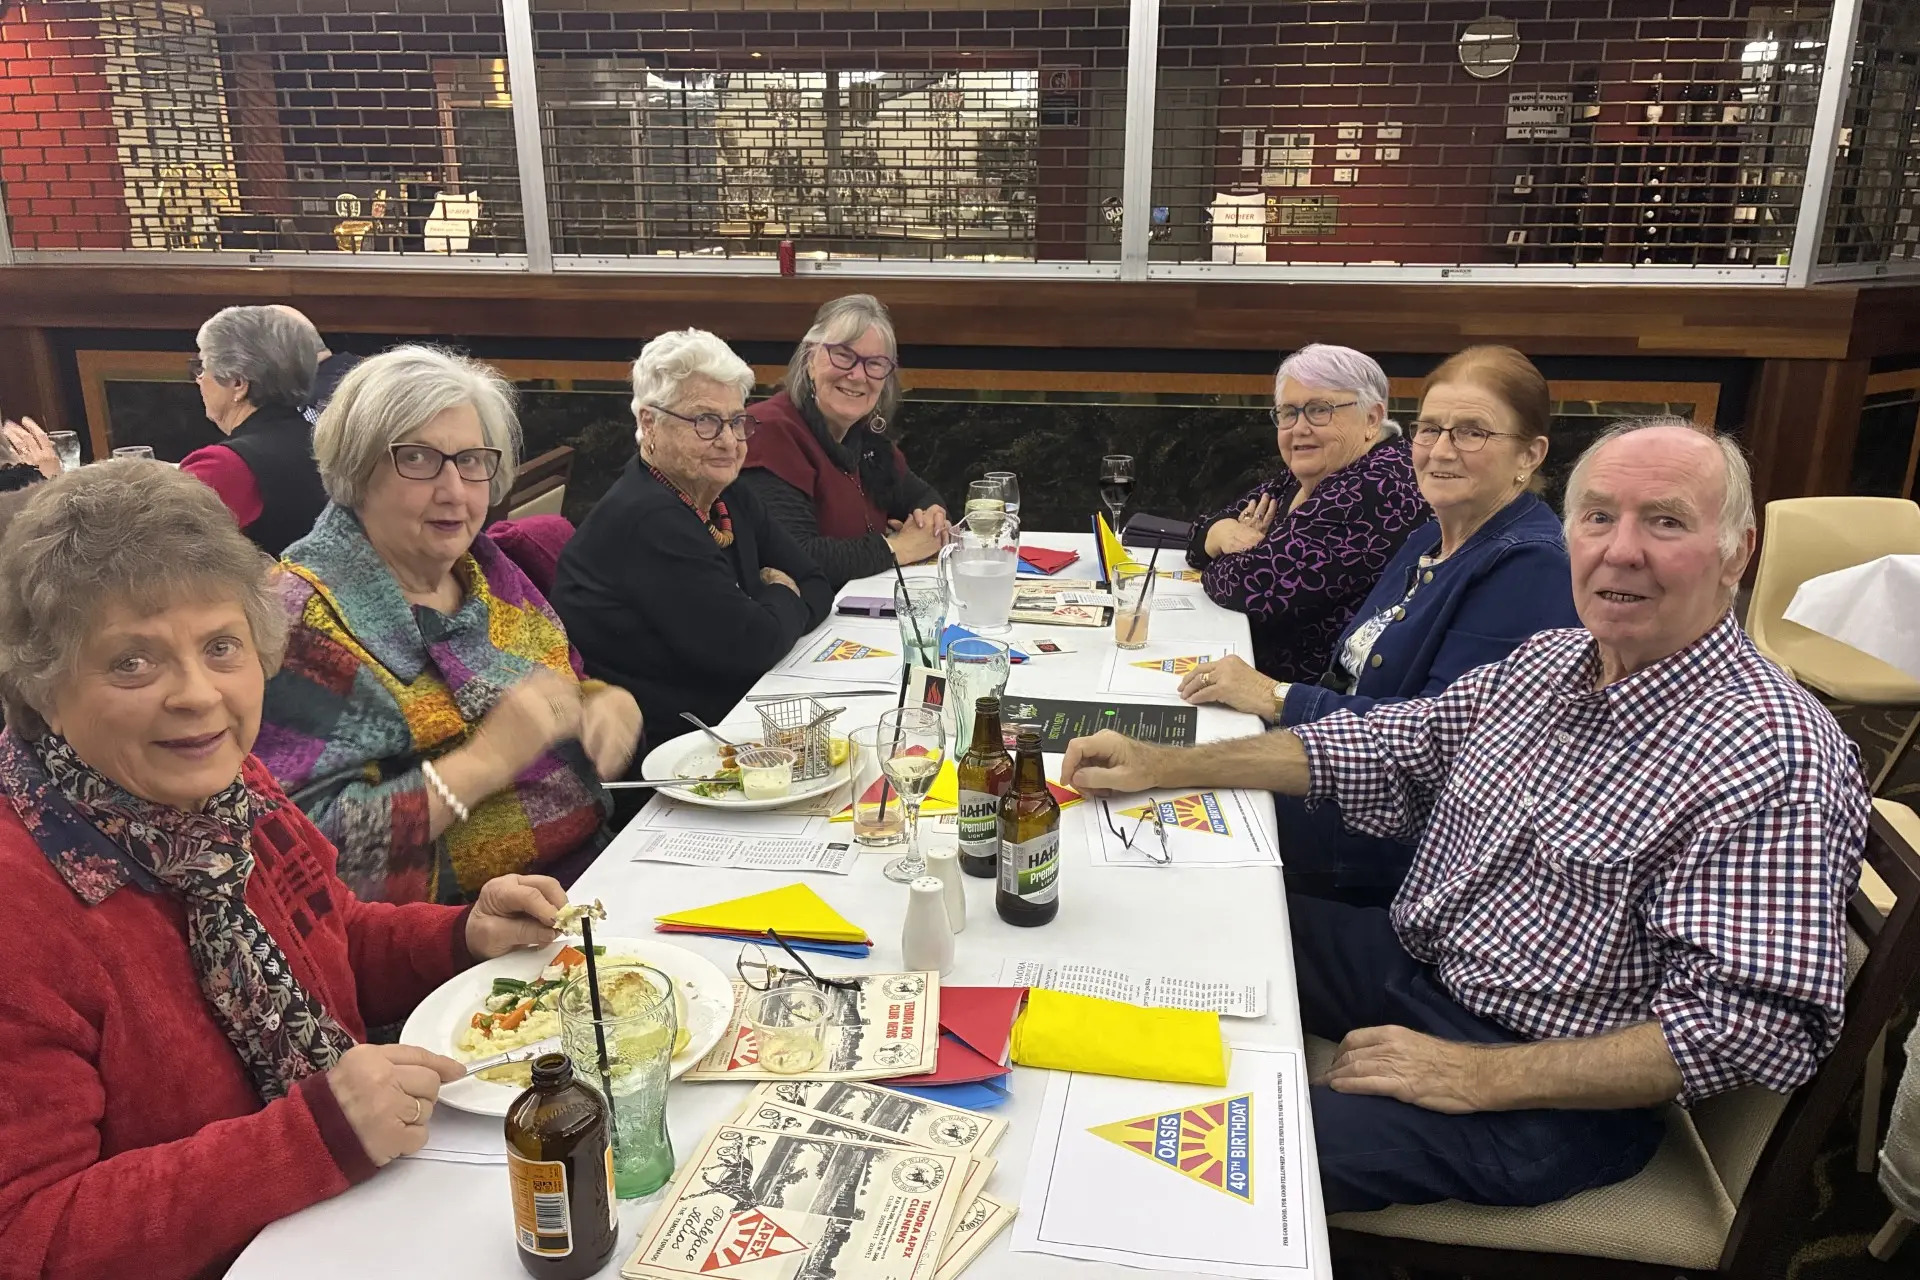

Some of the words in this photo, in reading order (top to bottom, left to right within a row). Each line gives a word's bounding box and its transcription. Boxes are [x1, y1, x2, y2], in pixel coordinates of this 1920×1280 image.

[1106, 206, 1123, 220] OLD
[960, 800, 996, 818] HAHN
[1161, 803, 1176, 823] OASIS
[1202, 794, 1222, 819] BIRTHDAY
[961, 820, 995, 832] Premium
[889, 1004, 900, 1020] CLUB
[903, 1000, 916, 1025] TEMORA
[886, 1022, 898, 1039] NEWS
[901, 1026, 913, 1040] APEX
[958, 1126, 978, 1146] TEMORA
[1158, 1117, 1178, 1160] OASIS
[1231, 1102, 1248, 1158] BIRTHDAY
[926, 1165, 944, 1190] TEMORA
[1230, 1160, 1246, 1190] 40TH
[677, 1206, 688, 1216] THE
[906, 1198, 920, 1218] CLUB
[912, 1200, 932, 1234] TEMORA
[665, 1218, 682, 1236] TEMORA
[672, 1206, 702, 1250] Adios
[896, 1219, 912, 1244] NEWS
[959, 1210, 985, 1231] TEMORA
[686, 1206, 724, 1262] Paleface
[746, 1222, 774, 1257] APEX
[902, 1235, 918, 1258] APEX
